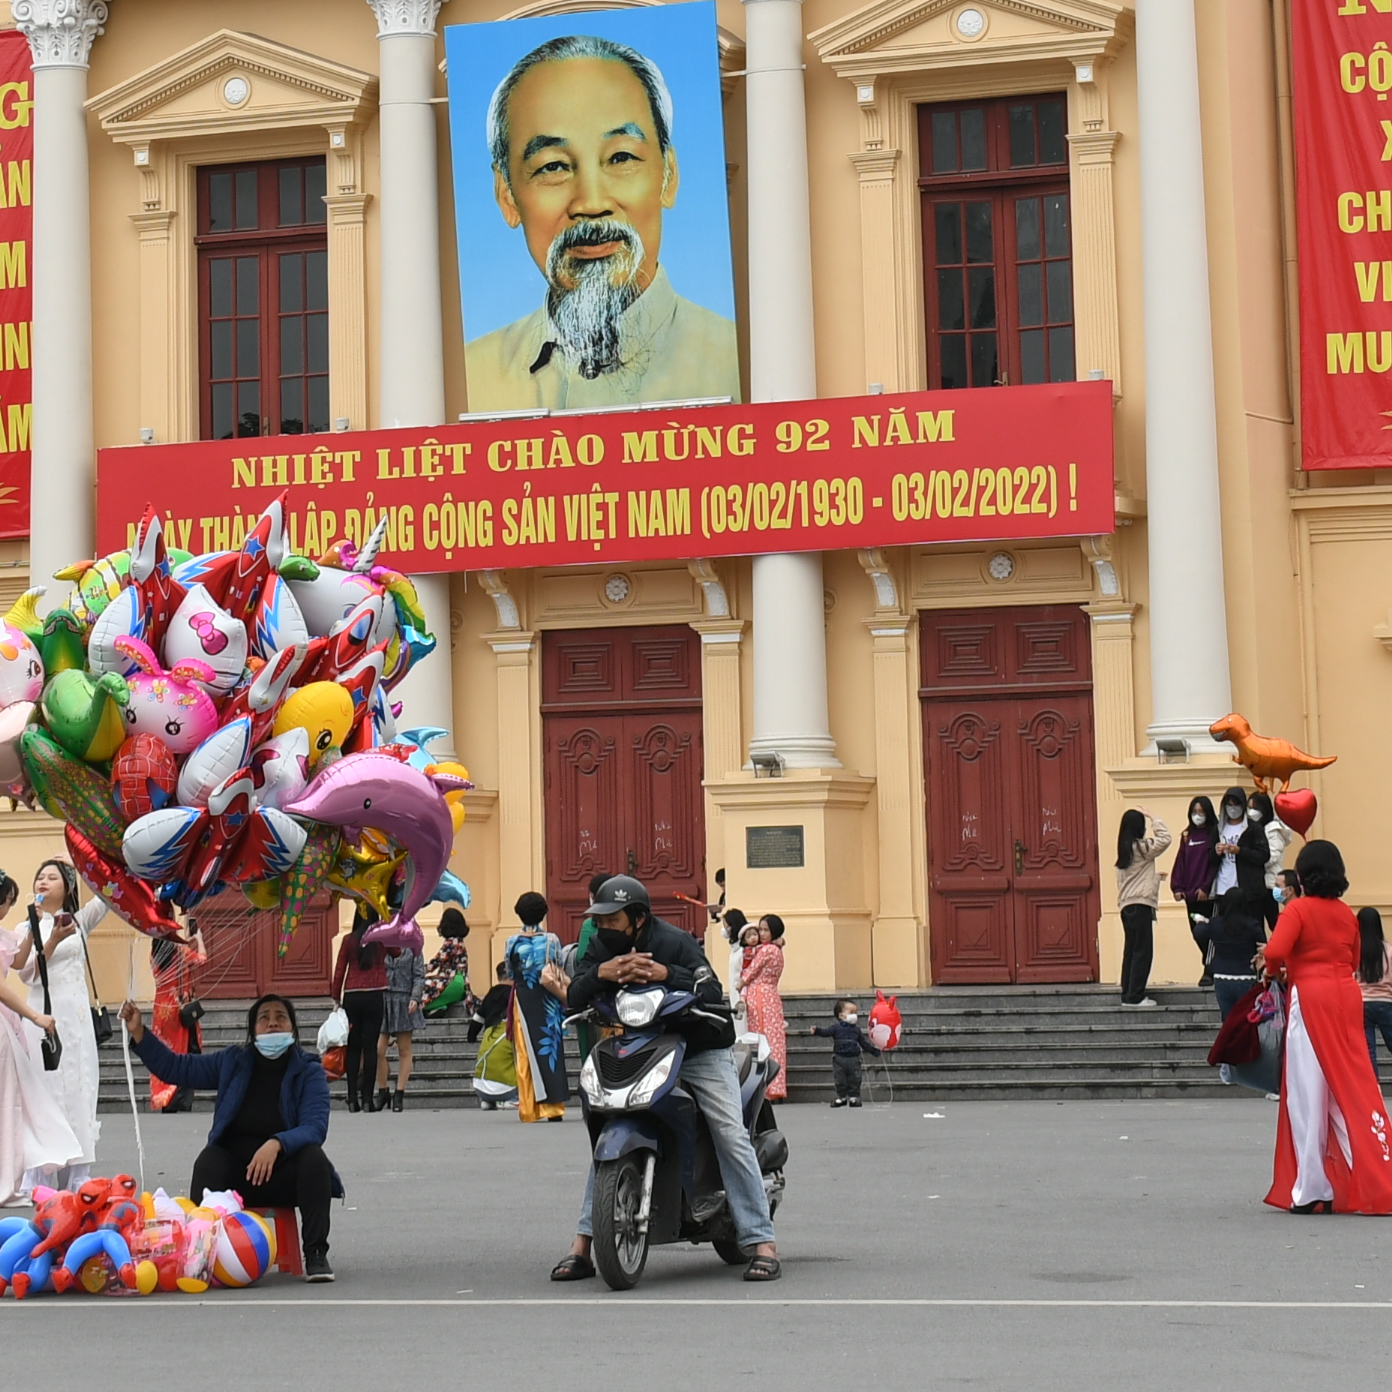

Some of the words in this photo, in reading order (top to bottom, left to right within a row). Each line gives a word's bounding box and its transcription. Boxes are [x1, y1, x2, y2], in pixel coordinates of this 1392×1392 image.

[231, 446, 362, 489] NHIỆT
[375, 438, 472, 481] LIỆT
[486, 429, 605, 472] CHÀO
[621, 421, 757, 463] MỪNG
[775, 419, 831, 452] 92
[851, 408, 956, 448] NĂM
[200, 505, 263, 552] THÀ
[344, 491, 415, 553] ĐẢNG
[423, 493, 493, 559] CỘNG
[501, 481, 558, 546] SẢN
[564, 483, 619, 551] VIỆT
[628, 487, 691, 539] NAM
[701, 476, 863, 539] (03/02/1930
[892, 465, 1057, 522] 03/02/2022)
